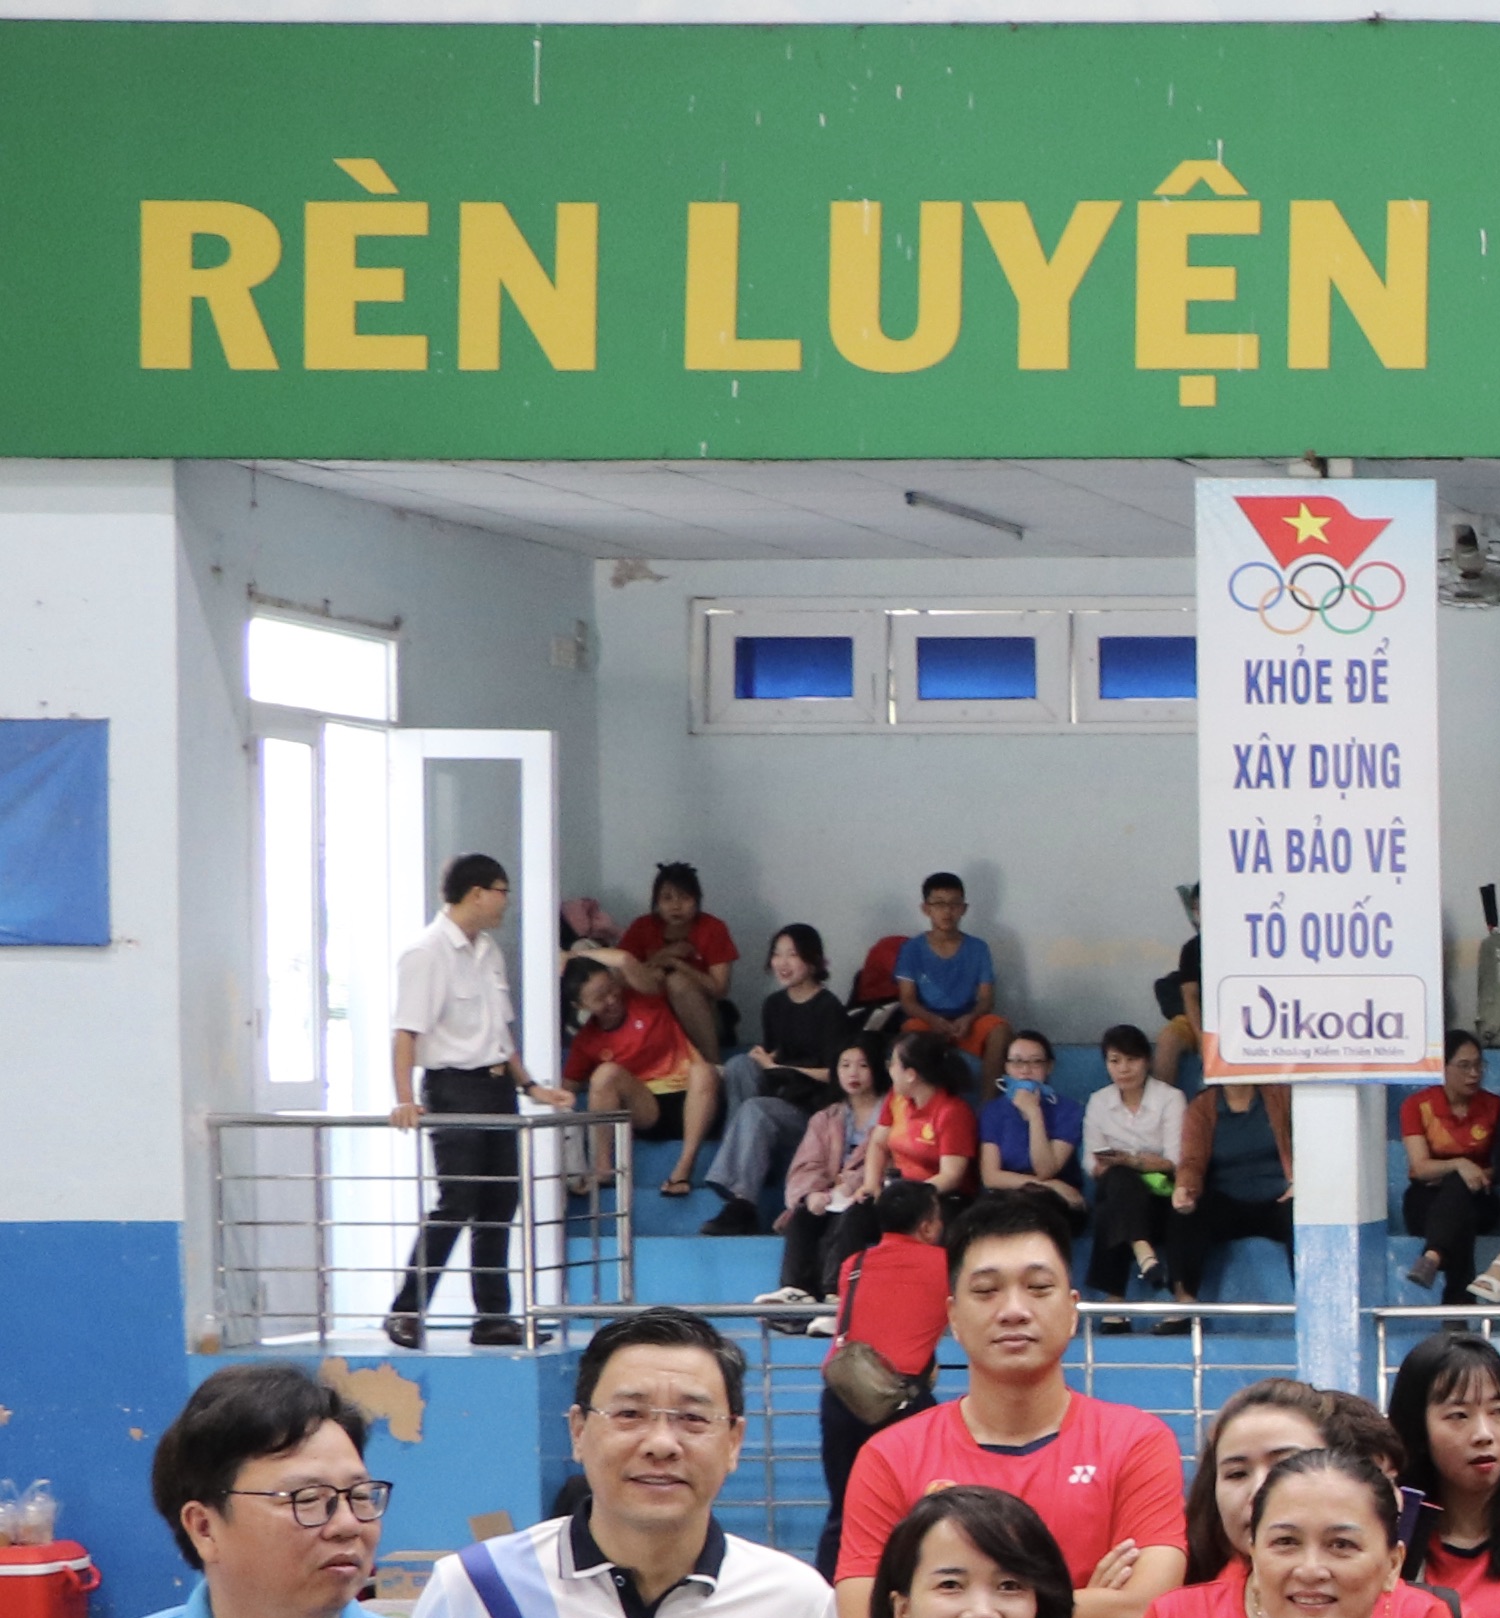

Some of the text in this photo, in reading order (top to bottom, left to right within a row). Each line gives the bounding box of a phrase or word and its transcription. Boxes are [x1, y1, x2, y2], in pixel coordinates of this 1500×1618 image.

[142, 159, 597, 370] RÈN
[686, 161, 1429, 405] LUYỆN
[1245, 638, 1389, 705] KHỎE ĐỂ
[1233, 733, 1400, 799] XÂY DỰNG
[1230, 815, 1406, 884] VÀ BẢO VỆ
[1245, 892, 1393, 963] TỔ QUỐC
